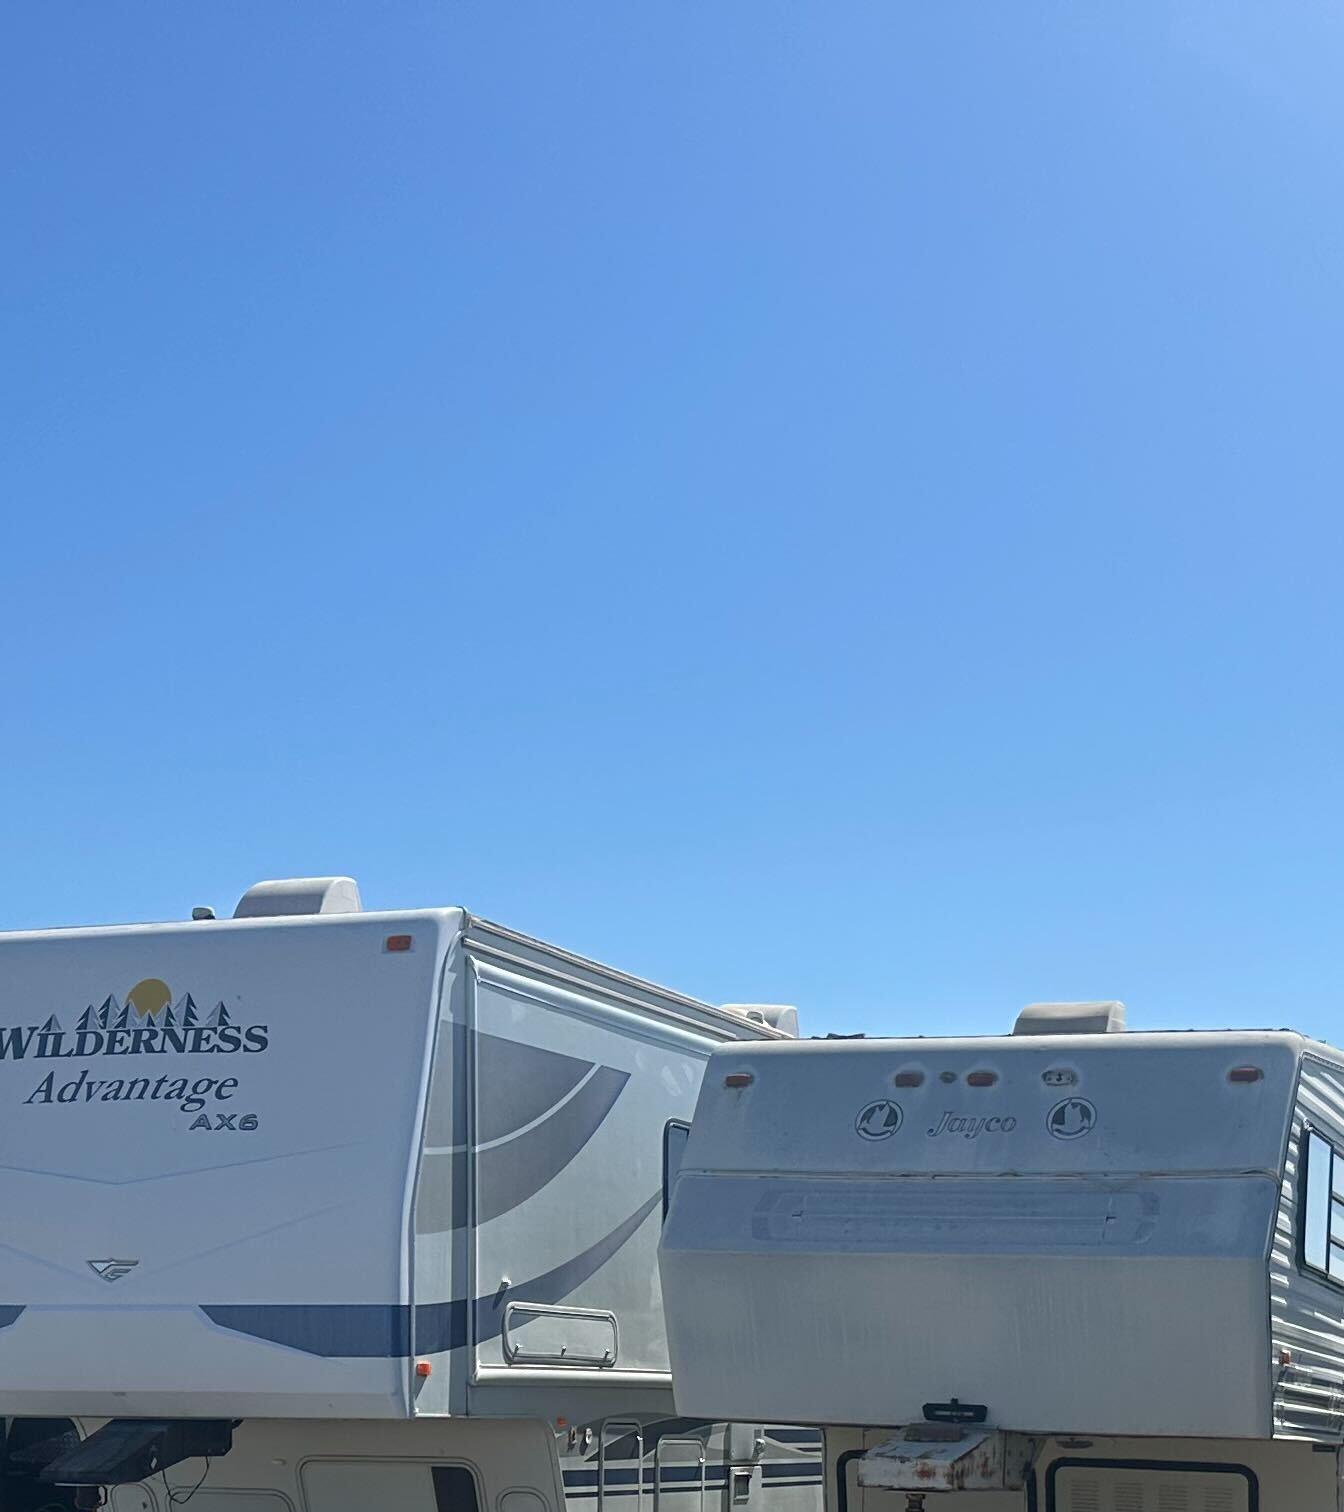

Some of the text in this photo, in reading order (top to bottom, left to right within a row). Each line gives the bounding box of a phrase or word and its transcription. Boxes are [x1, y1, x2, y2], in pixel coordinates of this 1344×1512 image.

[22, 1069, 238, 1112] Advantage
[189, 1113, 259, 1131] AX6
[927, 1111, 1017, 1138] Jayco
